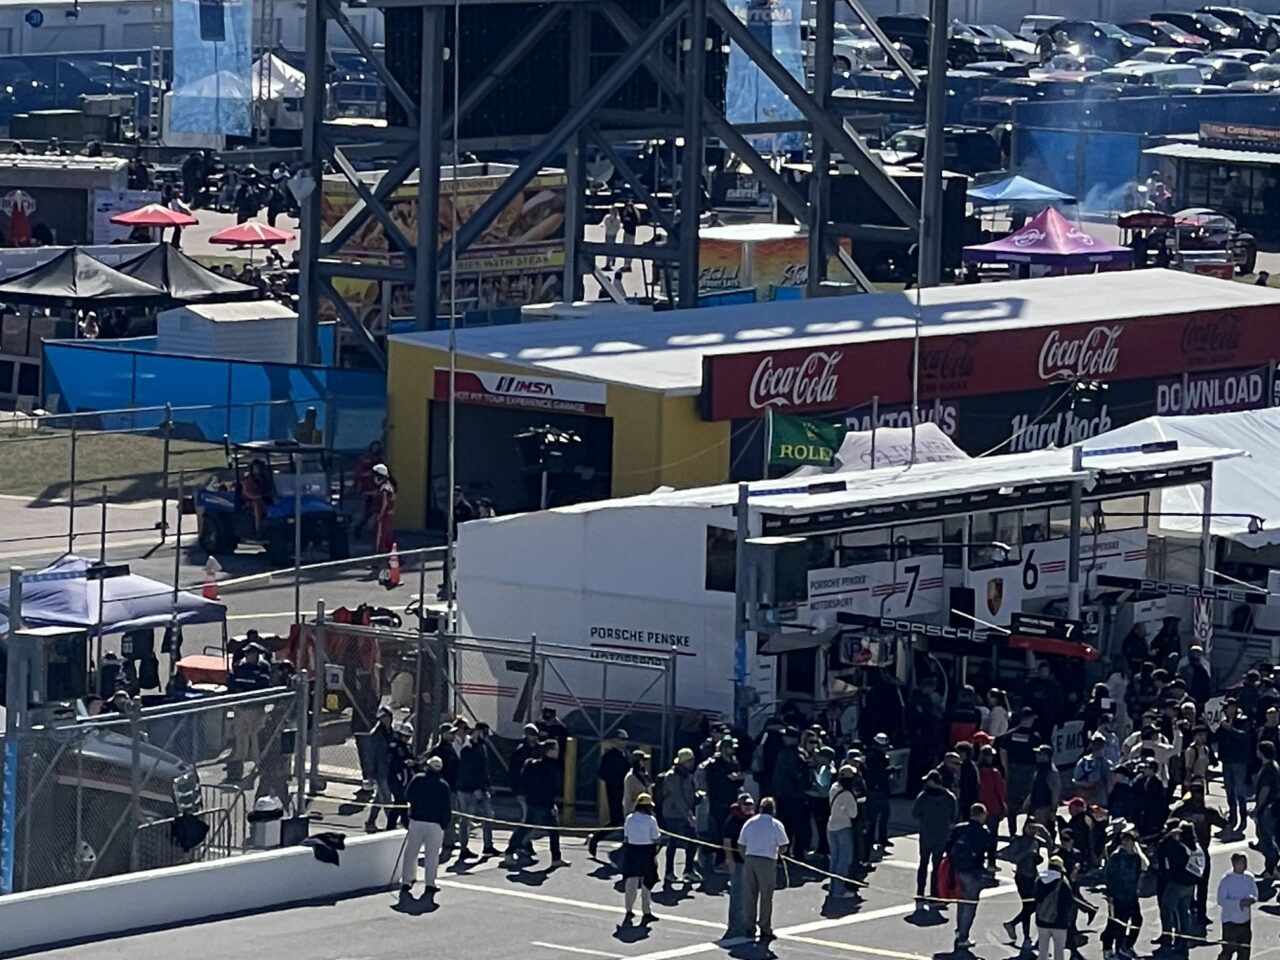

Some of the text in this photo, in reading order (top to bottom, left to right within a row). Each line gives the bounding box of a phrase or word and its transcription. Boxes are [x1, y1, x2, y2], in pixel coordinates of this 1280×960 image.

[1037, 324, 1125, 380] Coca-Cola
[514, 380, 554, 396] IMSA
[749, 350, 845, 410] Coca-Cola
[1157, 374, 1263, 413] DOWNLOAD
[505, 395, 552, 409] EXPERIENCE
[1022, 549, 1039, 591] 6
[904, 565, 921, 608] 7
[1141, 581, 1247, 602] PORSCHE
[590, 626, 691, 647] PORSCHE PENSKE
[881, 619, 992, 642] PORSCHE
[1065, 624, 1075, 639] 7
[505, 660, 539, 724] 7
